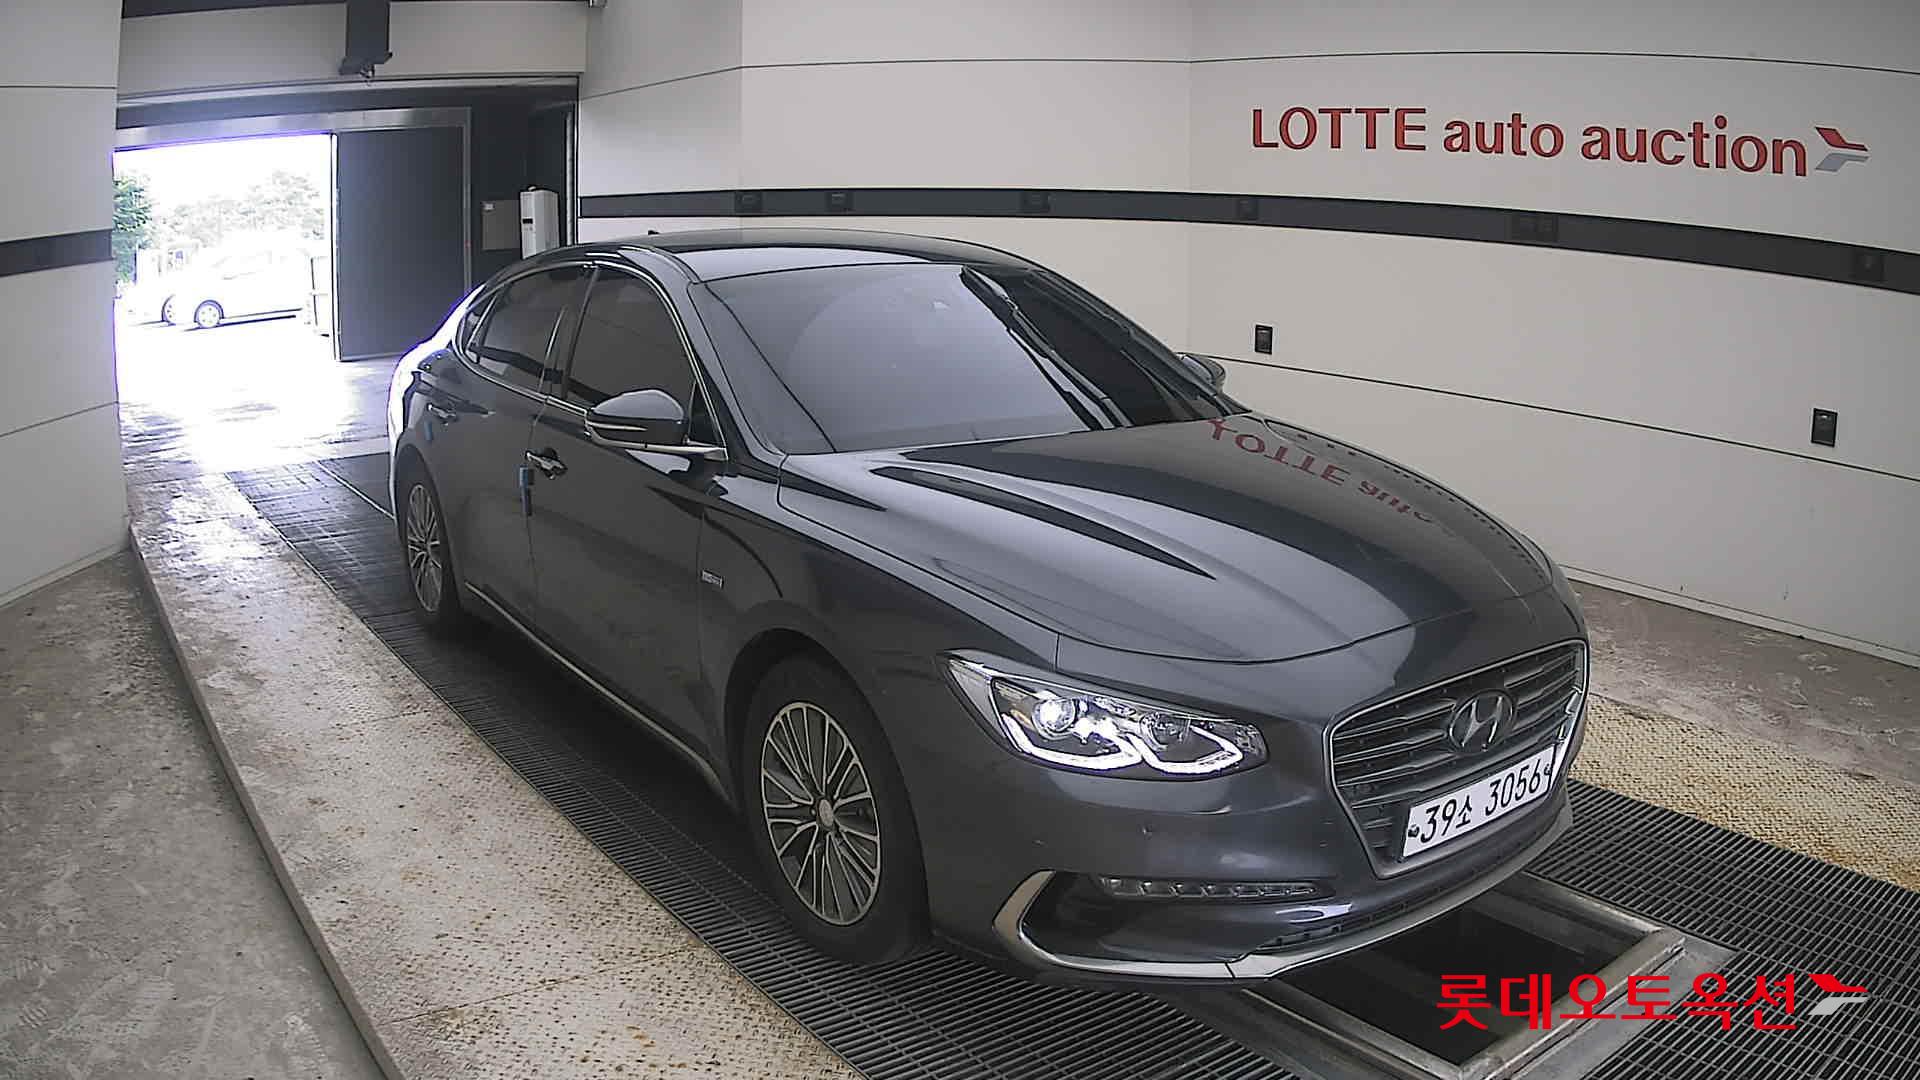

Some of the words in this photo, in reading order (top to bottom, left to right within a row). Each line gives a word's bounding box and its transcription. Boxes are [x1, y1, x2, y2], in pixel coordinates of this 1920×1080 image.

[1252, 107, 1426, 151] LOTTE
[1443, 113, 1565, 158] auto
[1581, 116, 1808, 176] auction
[1420, 794, 1473, 844] 39소
[1485, 758, 1541, 817] 3056
